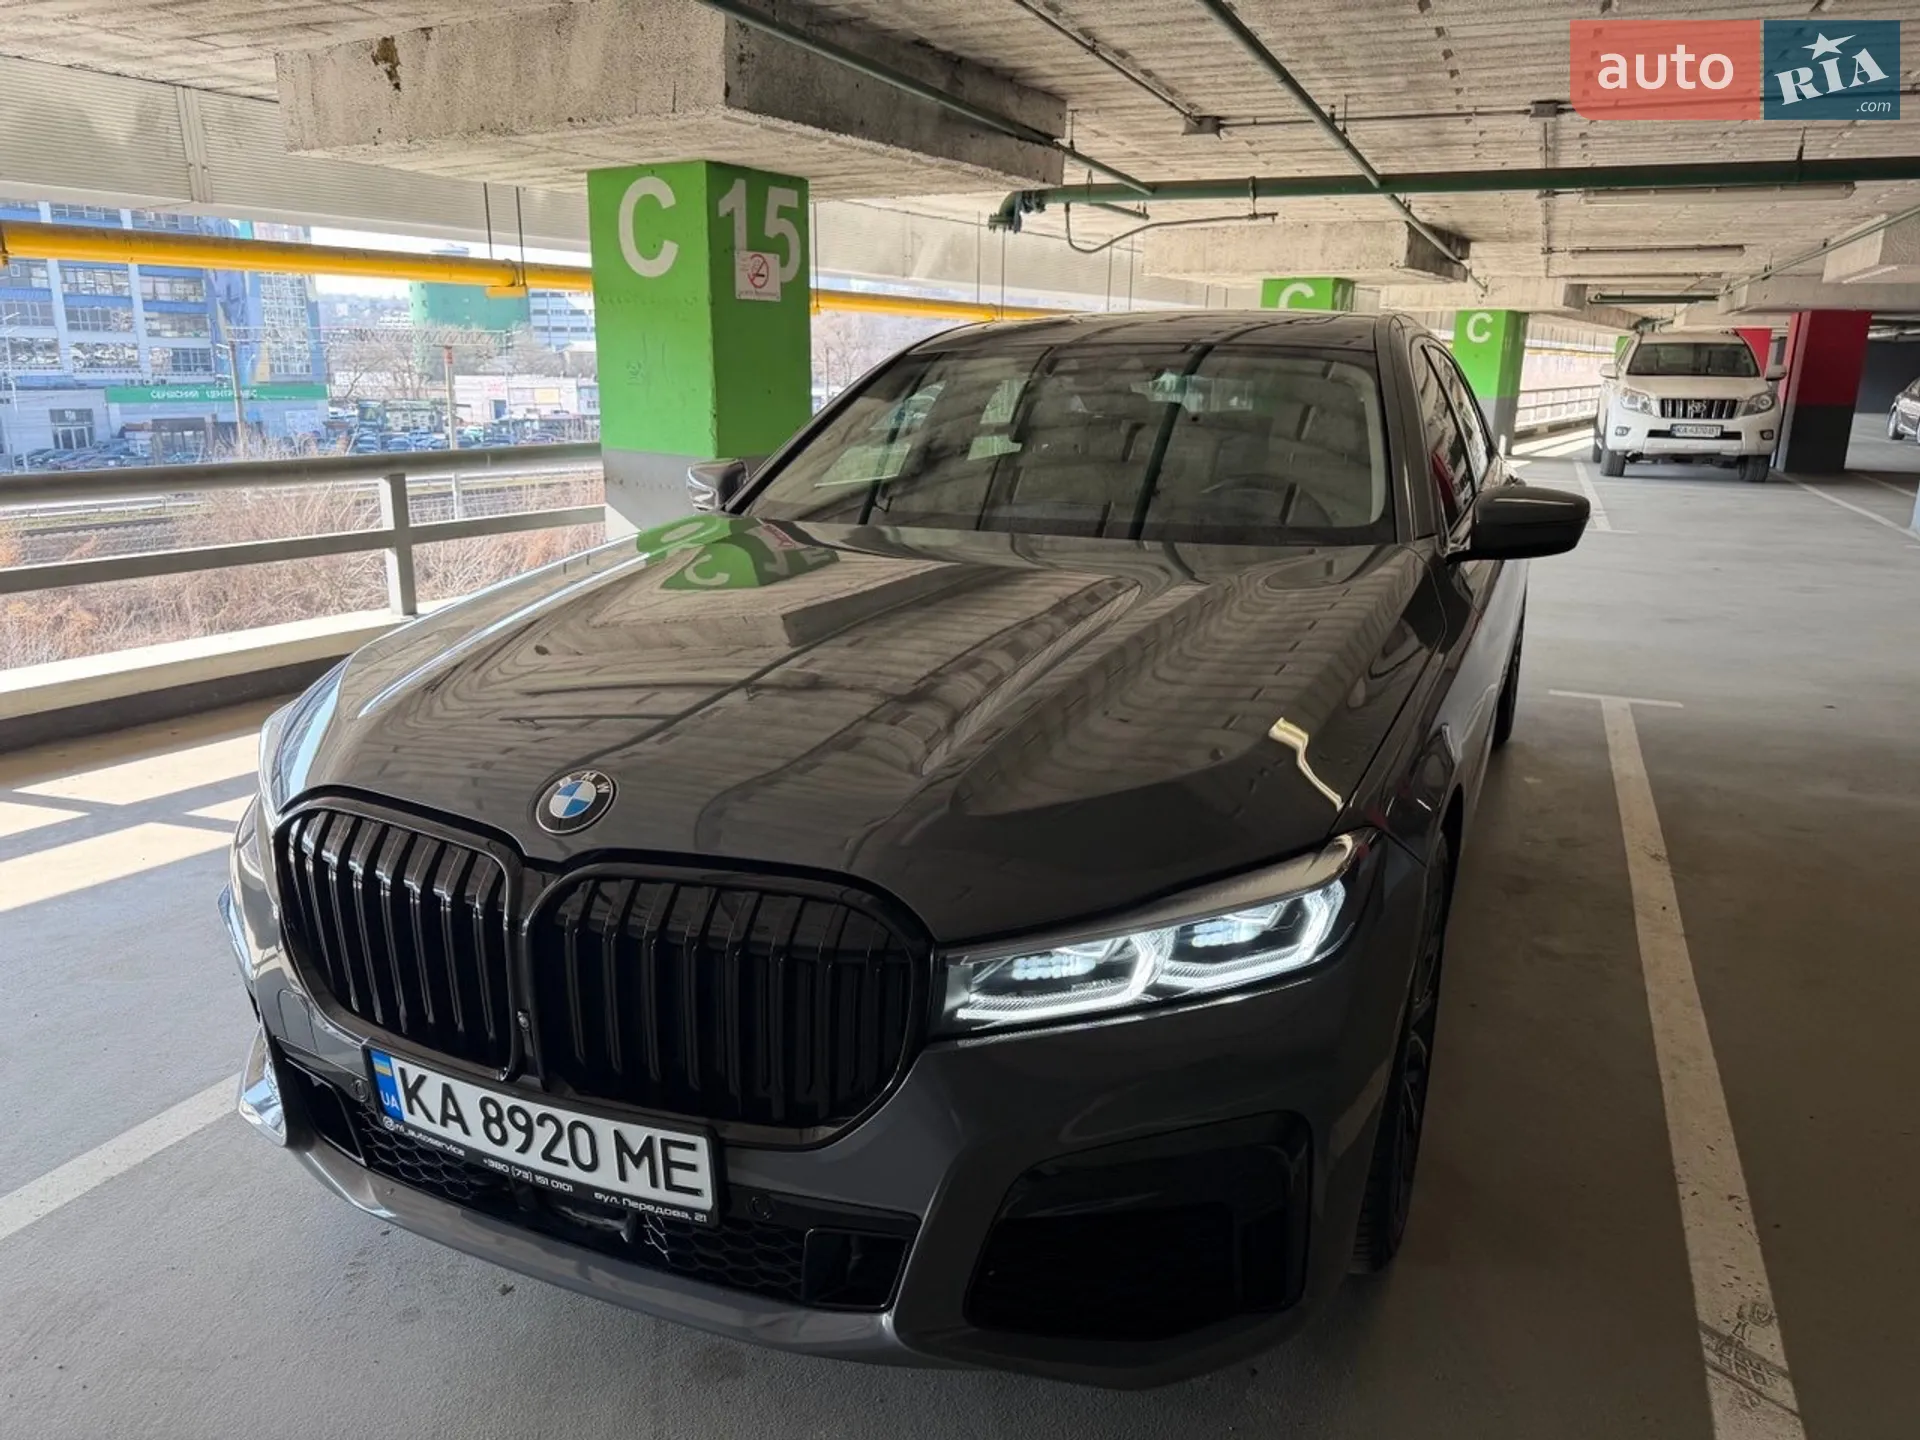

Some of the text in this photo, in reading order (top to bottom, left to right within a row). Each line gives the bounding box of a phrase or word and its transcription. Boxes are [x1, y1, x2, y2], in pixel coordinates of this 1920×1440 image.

[618, 176, 802, 284] C 15
[1466, 312, 1493, 343] C
[379, 1090, 401, 1111] UA
[398, 1066, 704, 1197] KA 8920 ME
